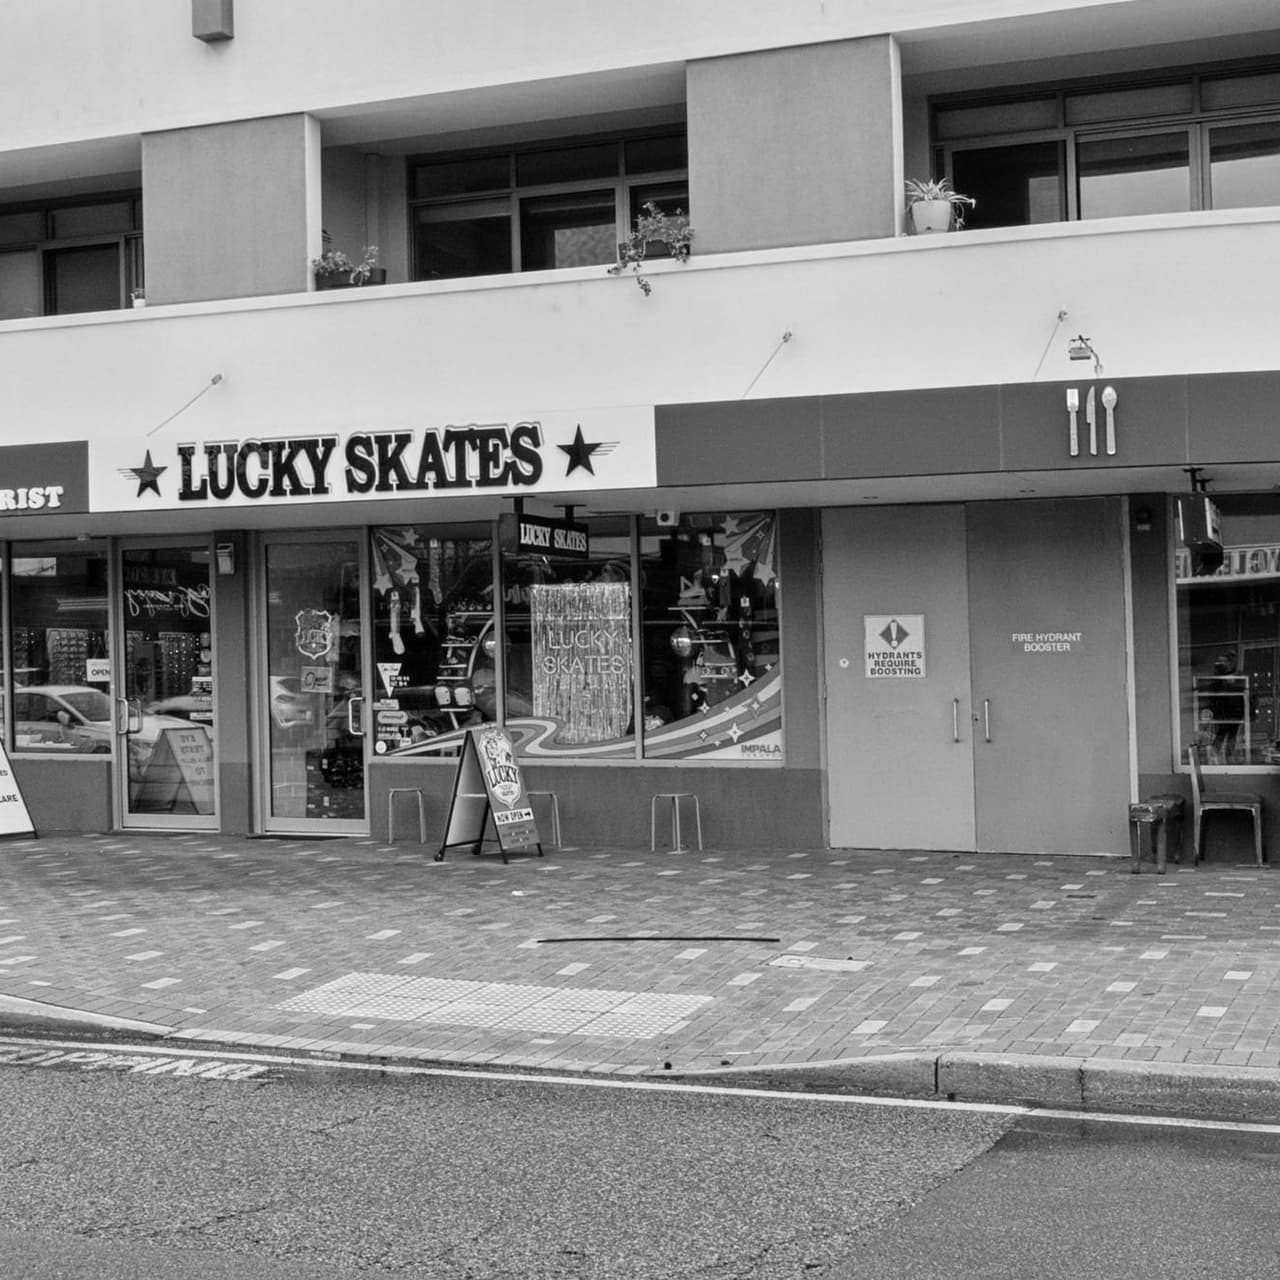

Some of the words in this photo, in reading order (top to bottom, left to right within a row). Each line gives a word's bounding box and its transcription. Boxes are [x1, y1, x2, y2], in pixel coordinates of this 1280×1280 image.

[177, 433, 340, 501] LUCKY
[343, 421, 545, 495] SKATES
[520, 523, 551, 547] LUCKY
[554, 529, 587, 552] SKATES
[548, 630, 618, 650] LUCKY
[1012, 633, 1034, 642] FIRE
[1035, 632, 1082, 642] HYDRANT
[1024, 643, 1071, 652] BOOSTER
[868, 651, 922, 660] HYDRANTS
[543, 656, 625, 674] SKATES
[874, 660, 917, 668] REQUIRE
[870, 667, 921, 675] BOOSTING
[741, 744, 781, 753] IMPALA
[488, 764, 519, 788] LUCKY
[510, 811, 524, 821] OPEN
